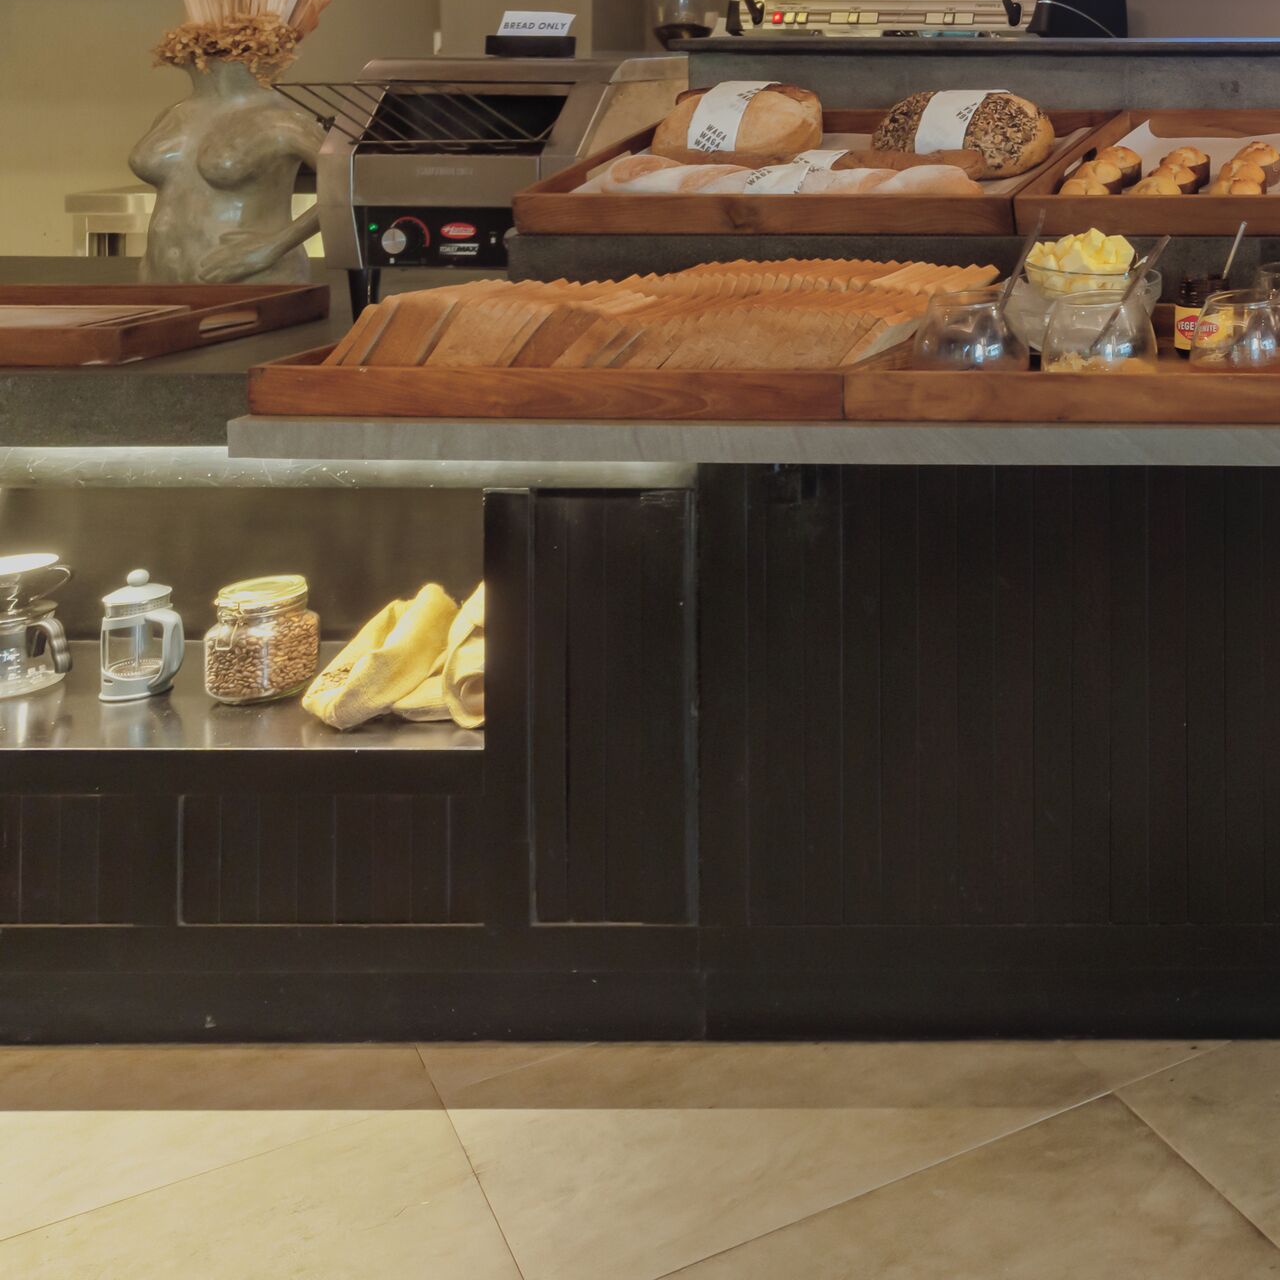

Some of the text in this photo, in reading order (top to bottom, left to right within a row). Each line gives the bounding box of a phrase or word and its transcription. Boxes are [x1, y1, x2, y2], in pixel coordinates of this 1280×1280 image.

[503, 22, 567, 30] BREAD ONLY
[699, 131, 722, 149] WAGA
[705, 123, 728, 142] WAGA
[746, 170, 773, 186] WAGA
